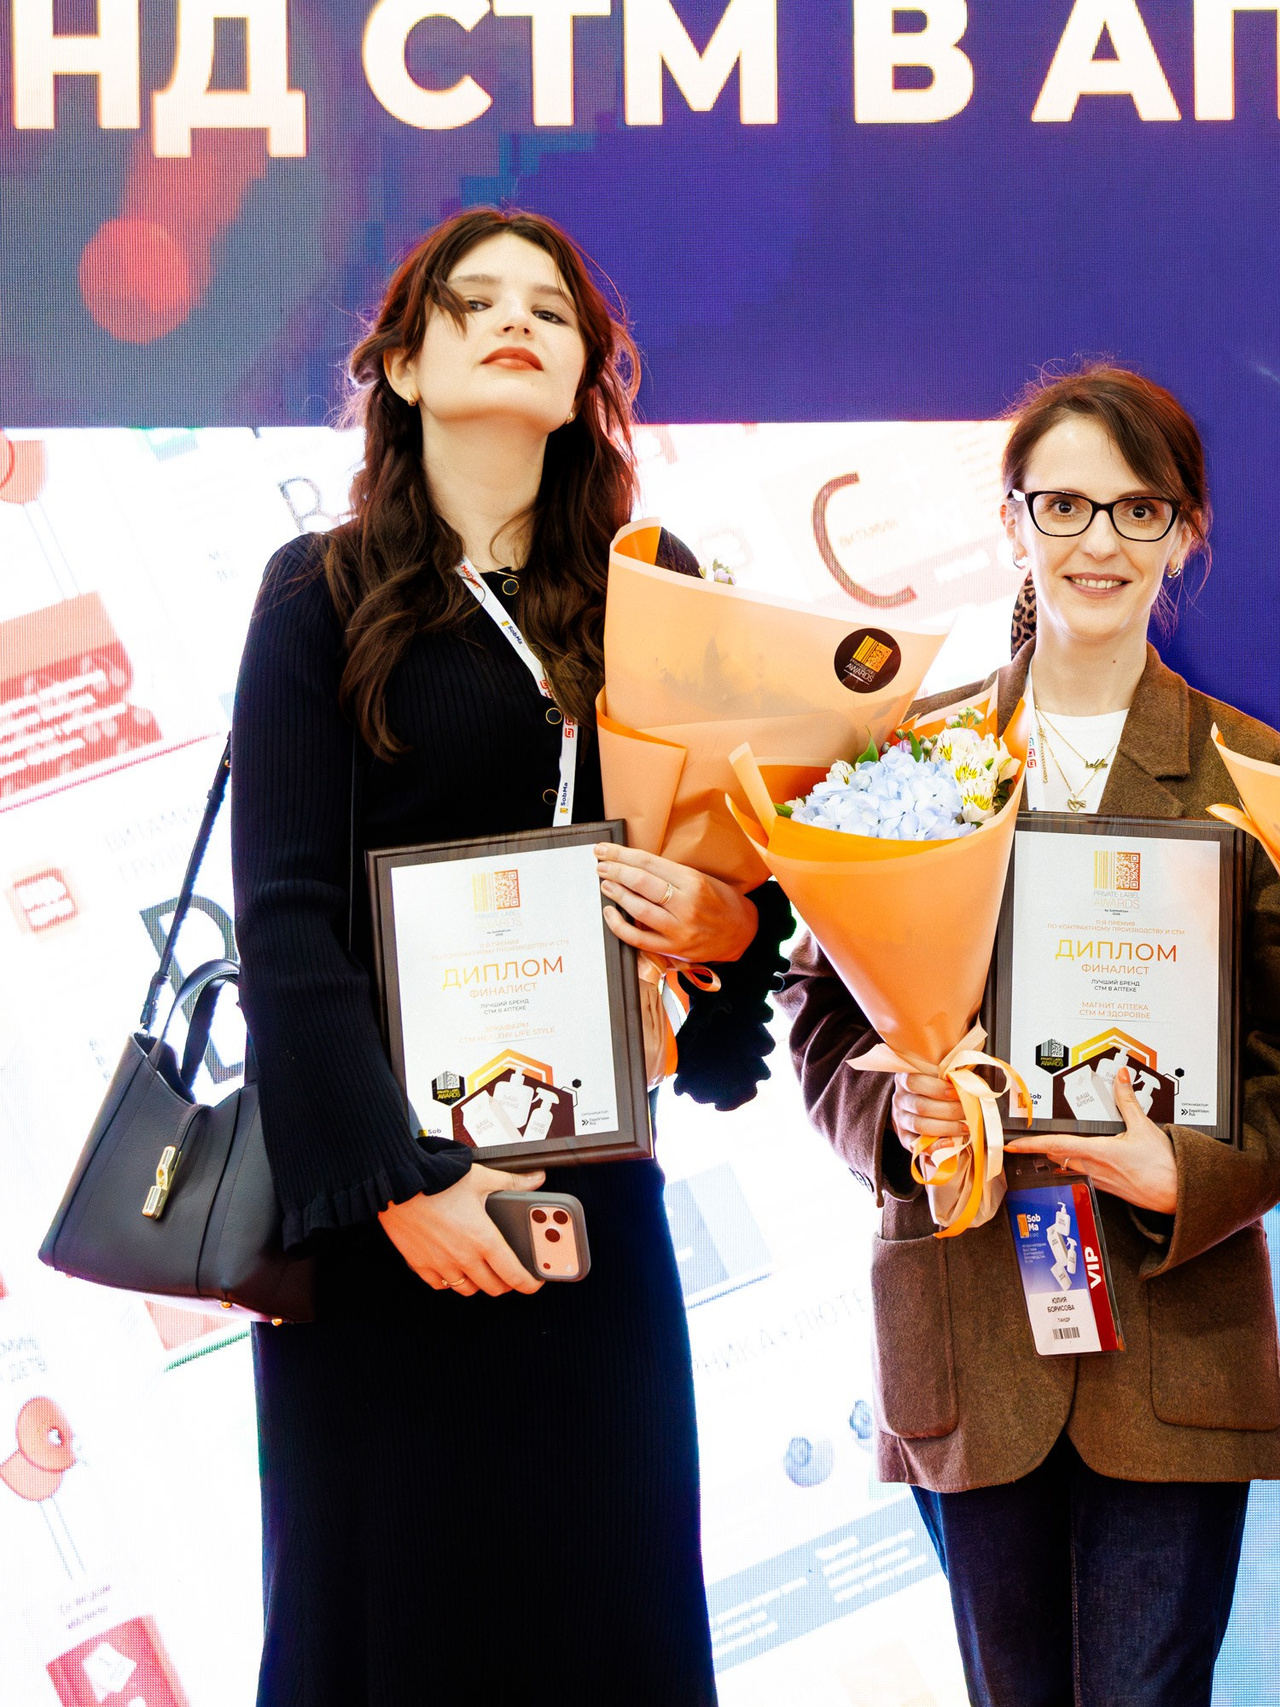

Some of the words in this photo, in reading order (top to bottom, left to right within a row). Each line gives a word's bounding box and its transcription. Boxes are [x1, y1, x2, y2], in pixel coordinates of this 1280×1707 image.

[362, 0, 780, 130] СТМ
[853, 0, 976, 124] В
[845, 662, 874, 683] AWARDS
[1093, 898, 1140, 910] AWARDS
[1055, 939, 1177, 962] ДИПЛОМ
[442, 955, 563, 991] ДИПЛОМ
[1081, 963, 1150, 976] ФИНАЛИСТ
[1091, 978, 1118, 986] ЛУЧШИЙ
[469, 982, 538, 998] ФИНАЛИСТ
[1081, 1001, 1116, 1010] МАГНИТ
[1117, 1003, 1149, 1011] АПТЕКА
[1107, 1011, 1151, 1019] ЗДОРОВЬЕ
[1026, 1213, 1041, 1223] Sob
[1028, 1223, 1040, 1232] Ma
[1084, 1246, 1102, 1290] VIP
[1051, 1296, 1068, 1304] ЮЛИЯ
[1047, 1304, 1076, 1313] БОРИСОВА
